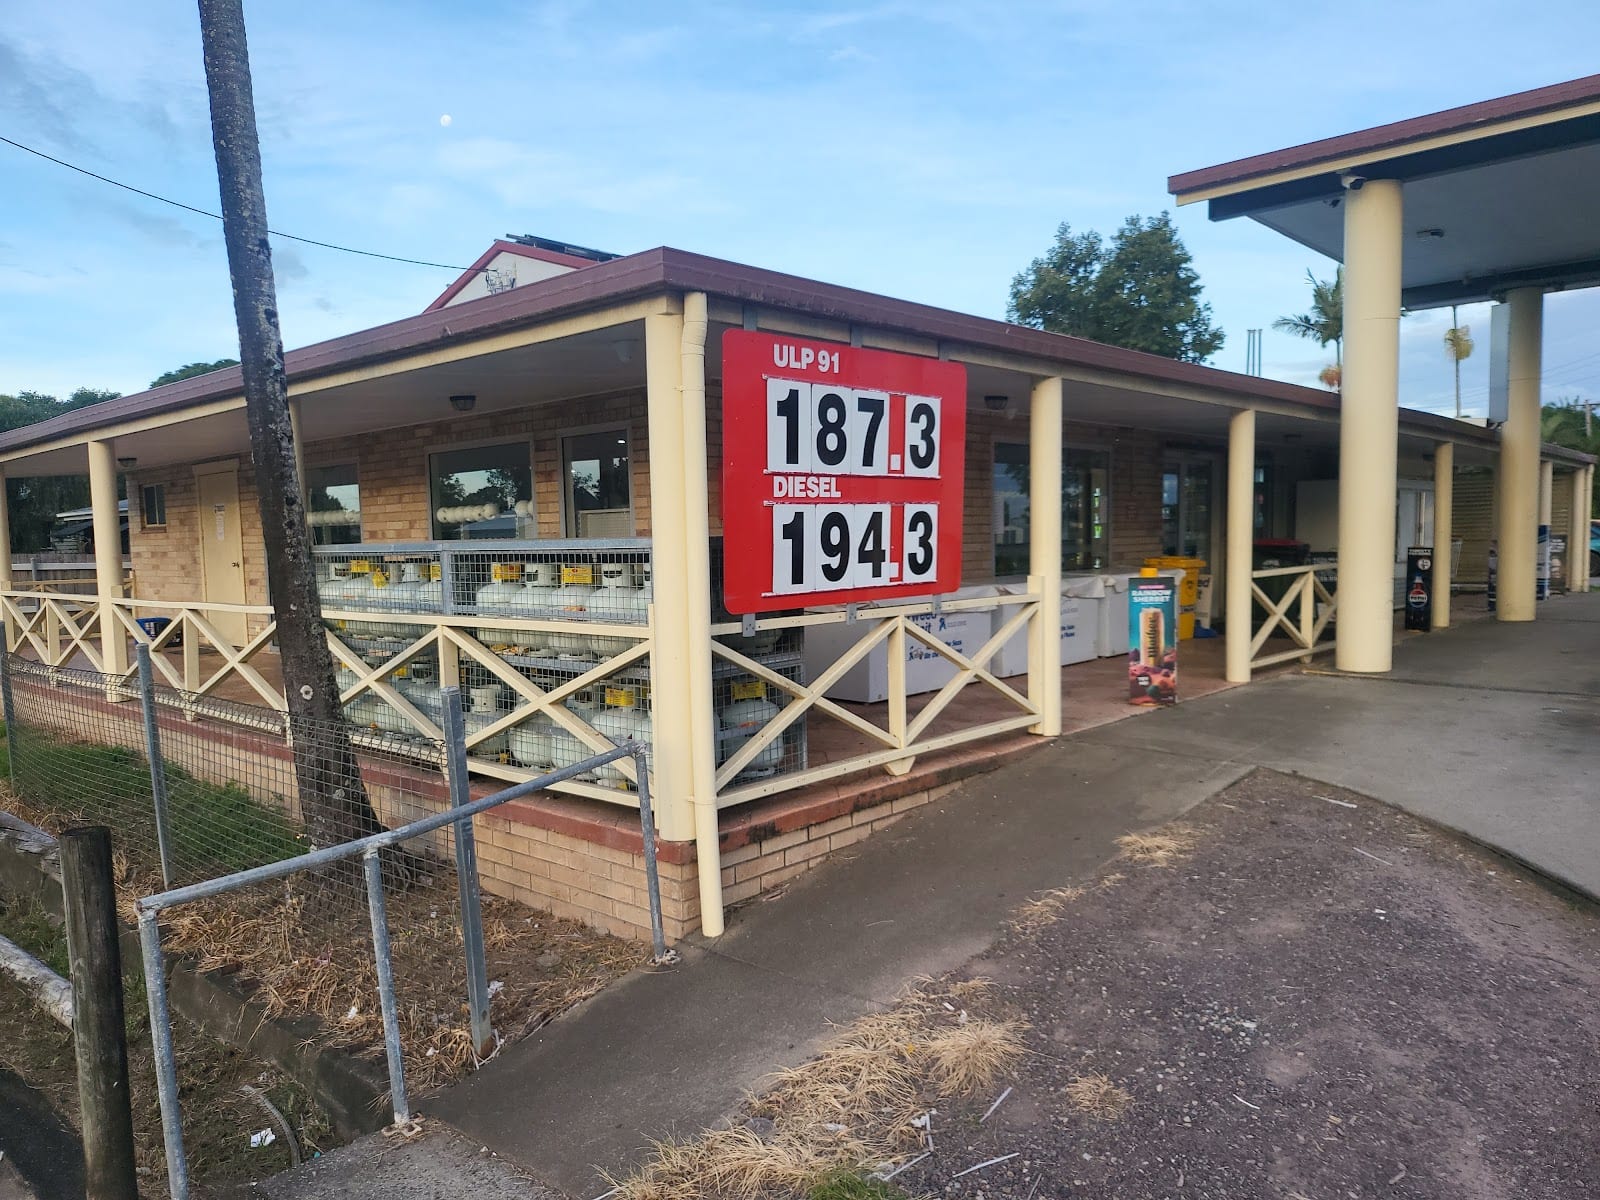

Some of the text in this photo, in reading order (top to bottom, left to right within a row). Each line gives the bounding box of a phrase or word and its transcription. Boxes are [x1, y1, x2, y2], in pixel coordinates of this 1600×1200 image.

[773, 343, 840, 374] ULP 91
[776, 388, 936, 470] 187.3
[773, 475, 842, 498] DIESEL
[782, 510, 934, 586] 194.3
